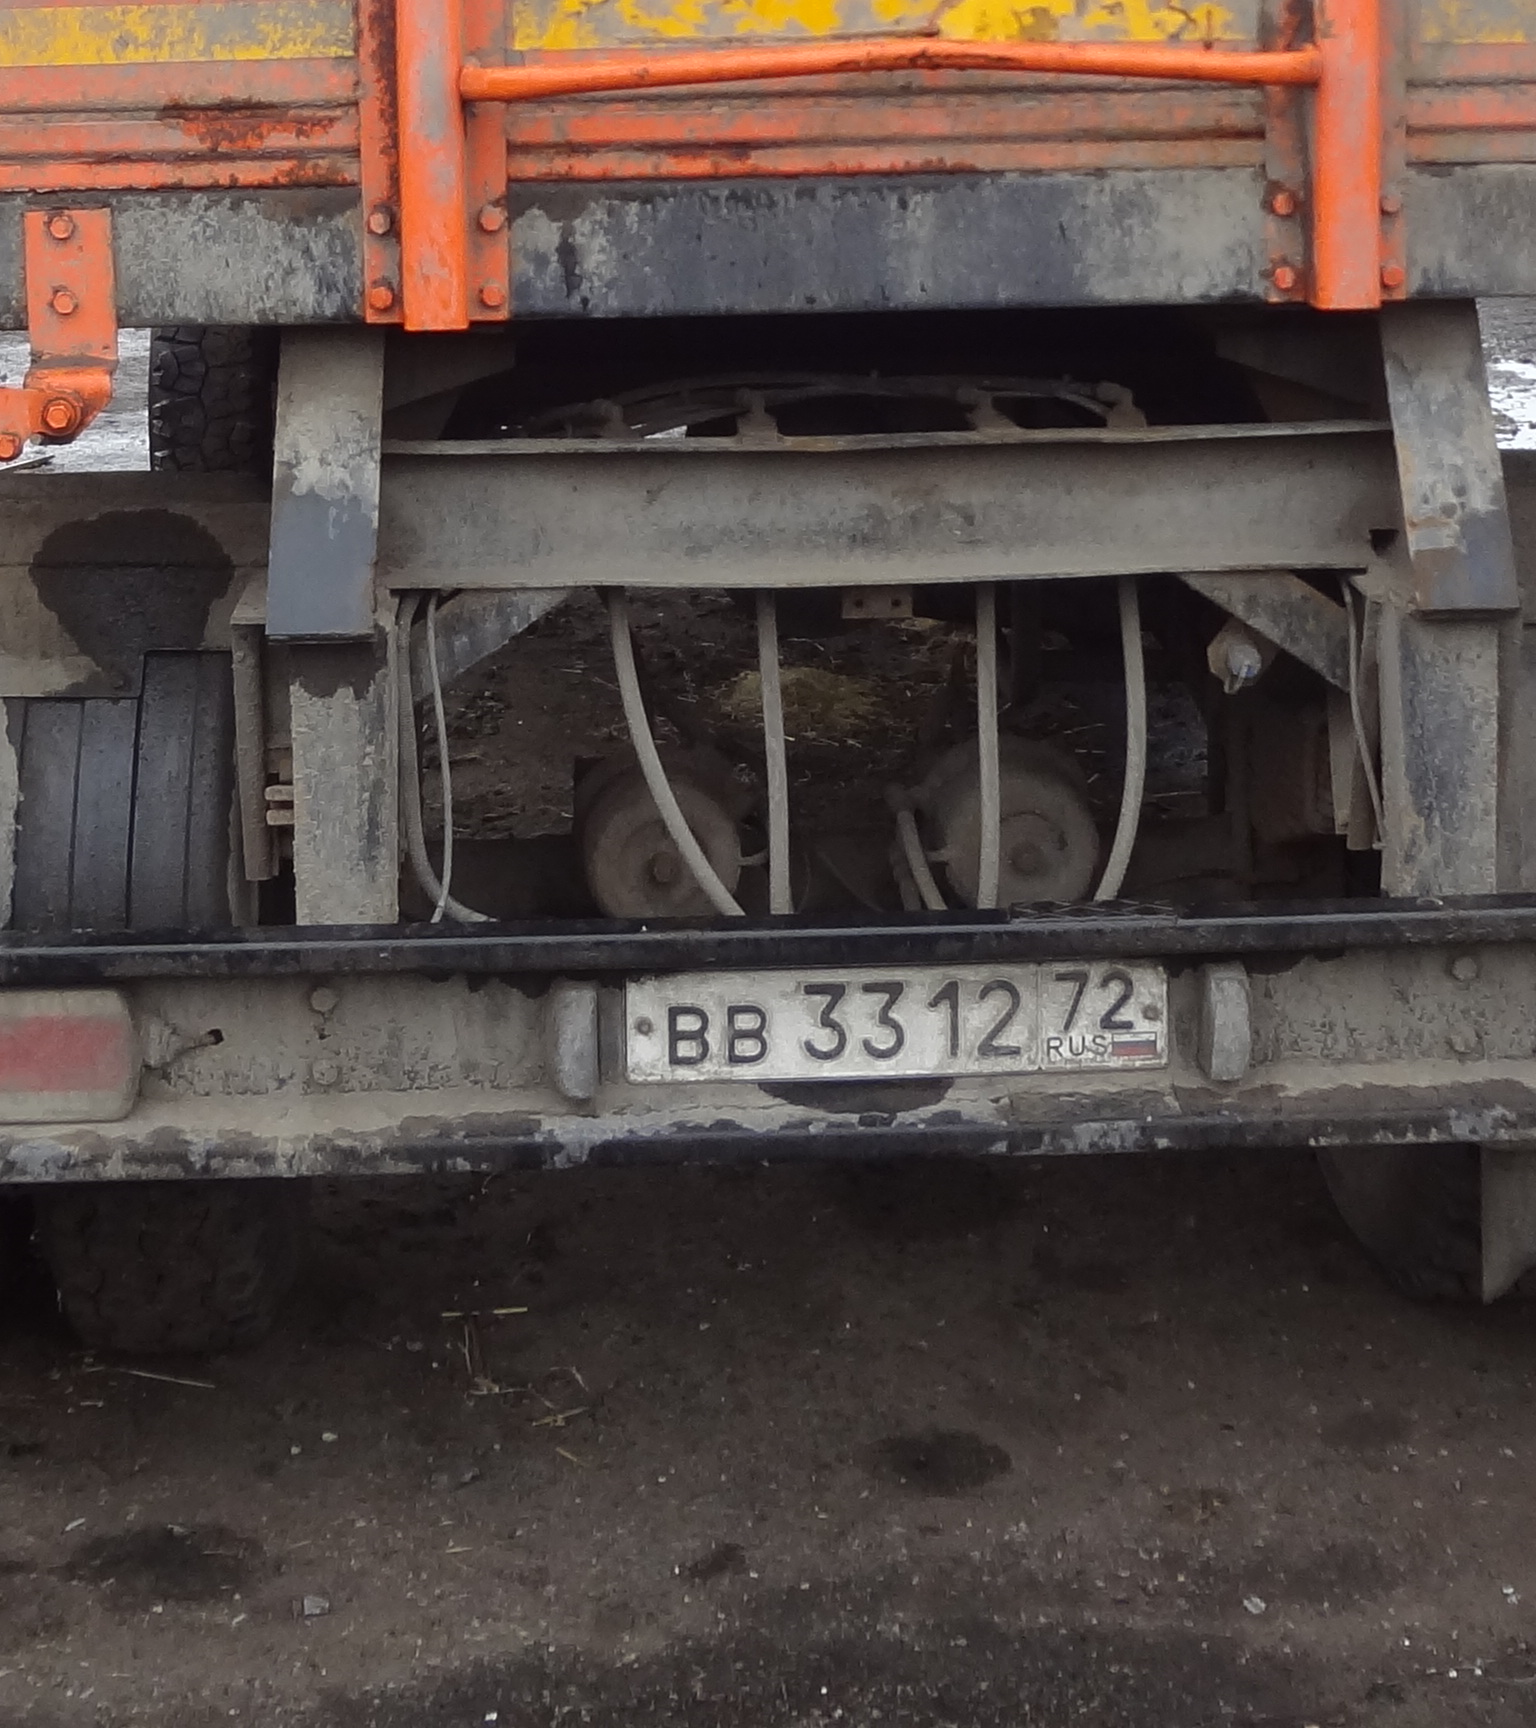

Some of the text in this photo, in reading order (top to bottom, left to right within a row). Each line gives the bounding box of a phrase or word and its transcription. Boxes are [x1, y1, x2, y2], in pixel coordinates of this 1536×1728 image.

[803, 978, 1022, 1061] 3312
[1054, 971, 1135, 1032] 72
[1046, 1034, 1109, 1058] RUS
